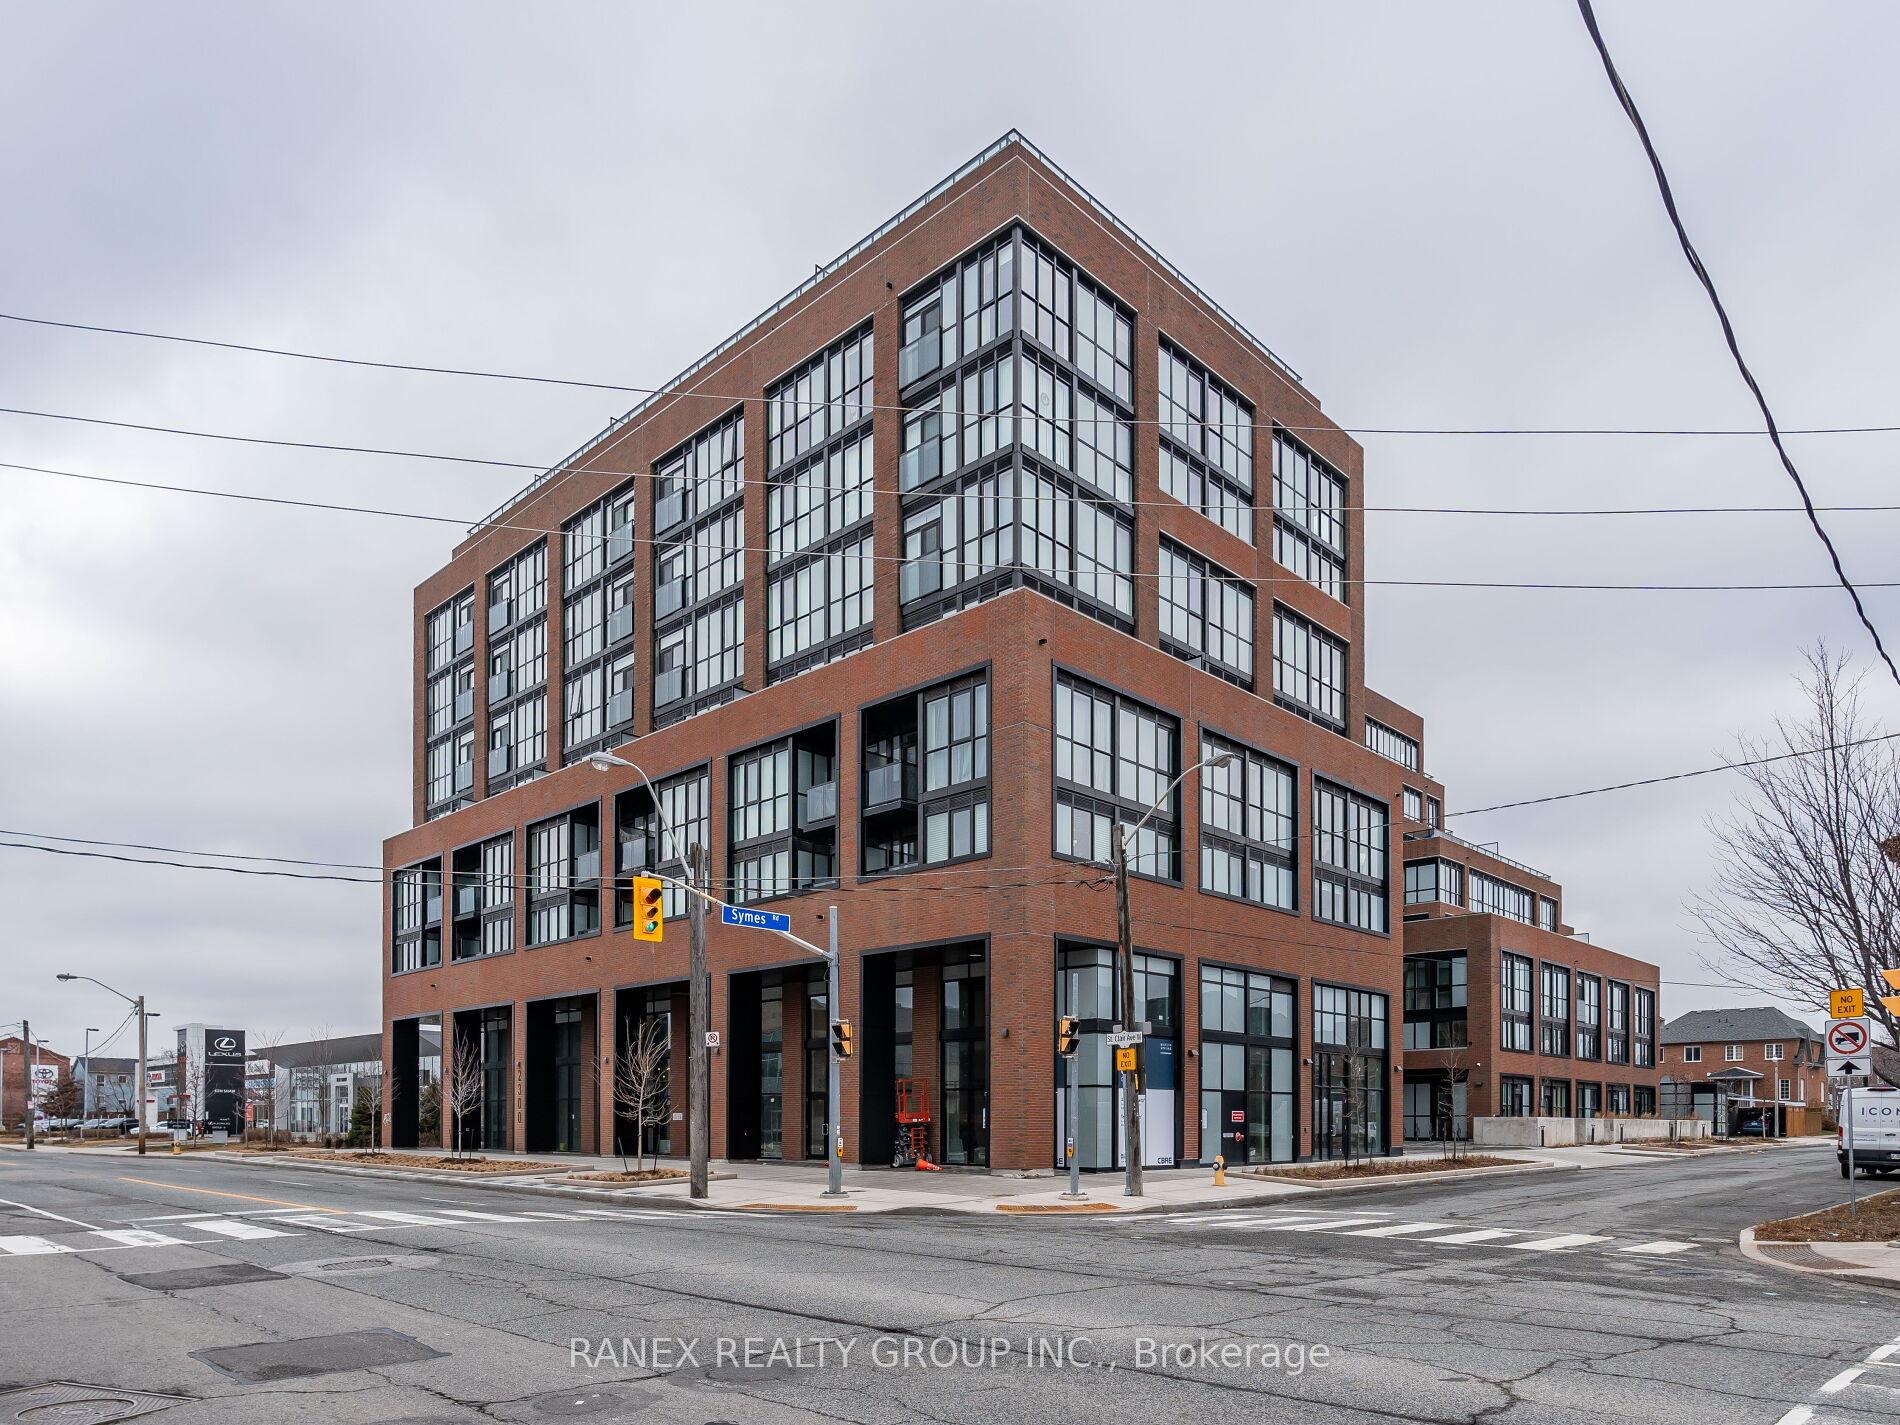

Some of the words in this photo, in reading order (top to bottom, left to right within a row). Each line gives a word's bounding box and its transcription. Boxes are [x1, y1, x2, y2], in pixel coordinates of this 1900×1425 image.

[732, 909, 766, 925] Symes
[1840, 995, 1853, 1004] NO
[1837, 1005, 1856, 1014] EXIT
